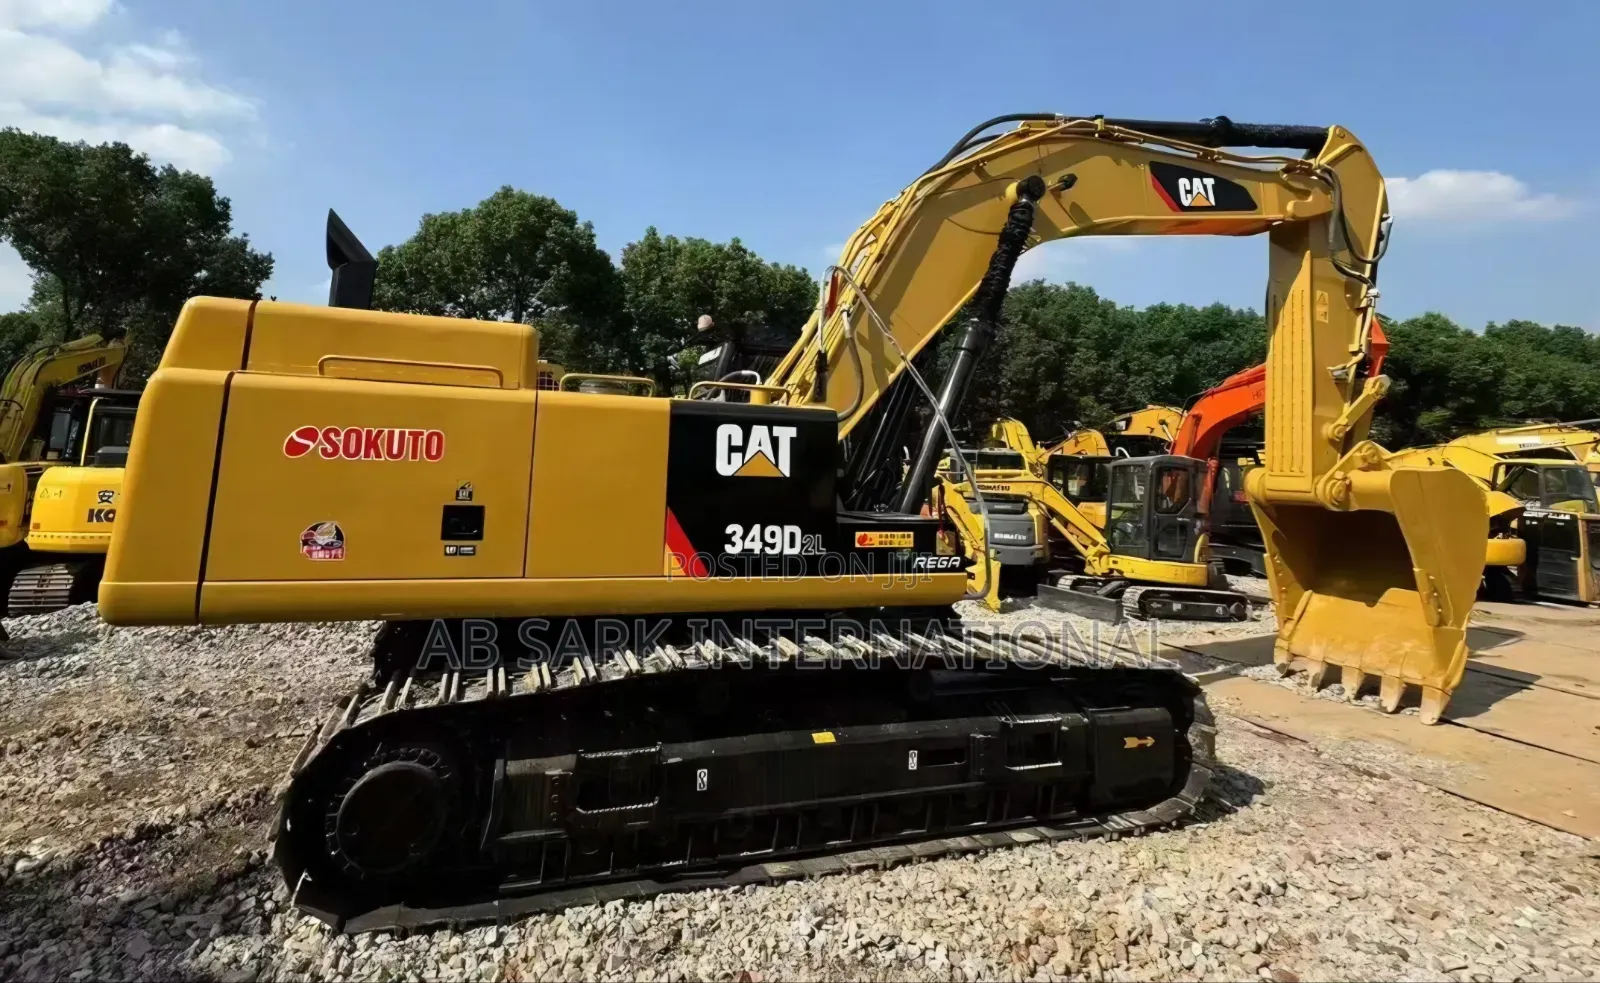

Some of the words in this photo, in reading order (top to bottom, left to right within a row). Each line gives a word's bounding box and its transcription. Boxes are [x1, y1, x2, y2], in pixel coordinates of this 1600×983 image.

[1178, 177, 1216, 207] CAT
[319, 426, 445, 462] SOKUTO
[716, 423, 798, 477] CAT
[913, 556, 961, 569] REGA
